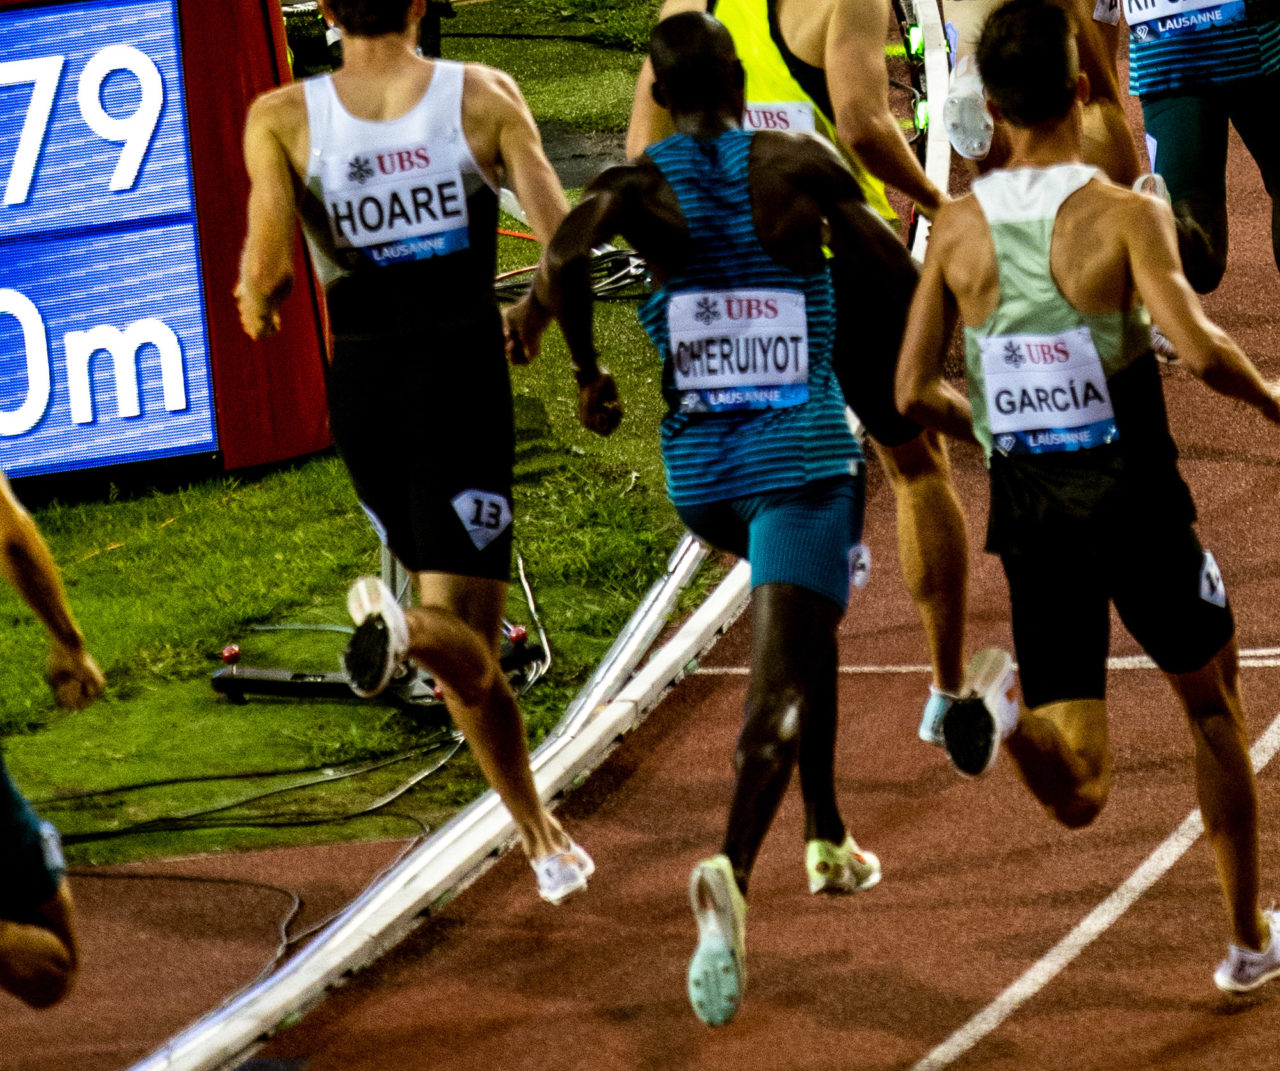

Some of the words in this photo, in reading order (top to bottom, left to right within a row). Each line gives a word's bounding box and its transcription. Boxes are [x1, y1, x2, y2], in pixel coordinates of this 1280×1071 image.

[1157, 9, 1223, 32] LAUSANNE
[744, 109, 791, 130] UBS
[376, 147, 431, 175] UBS
[331, 180, 463, 237] HOARE
[371, 236, 447, 261] LAUSANNE
[725, 297, 779, 320] UBS
[676, 335, 803, 378] CHERUIYOT
[1025, 341, 1071, 365] UBS
[995, 379, 1106, 415] GARCÍA
[469, 498, 503, 530] 13
